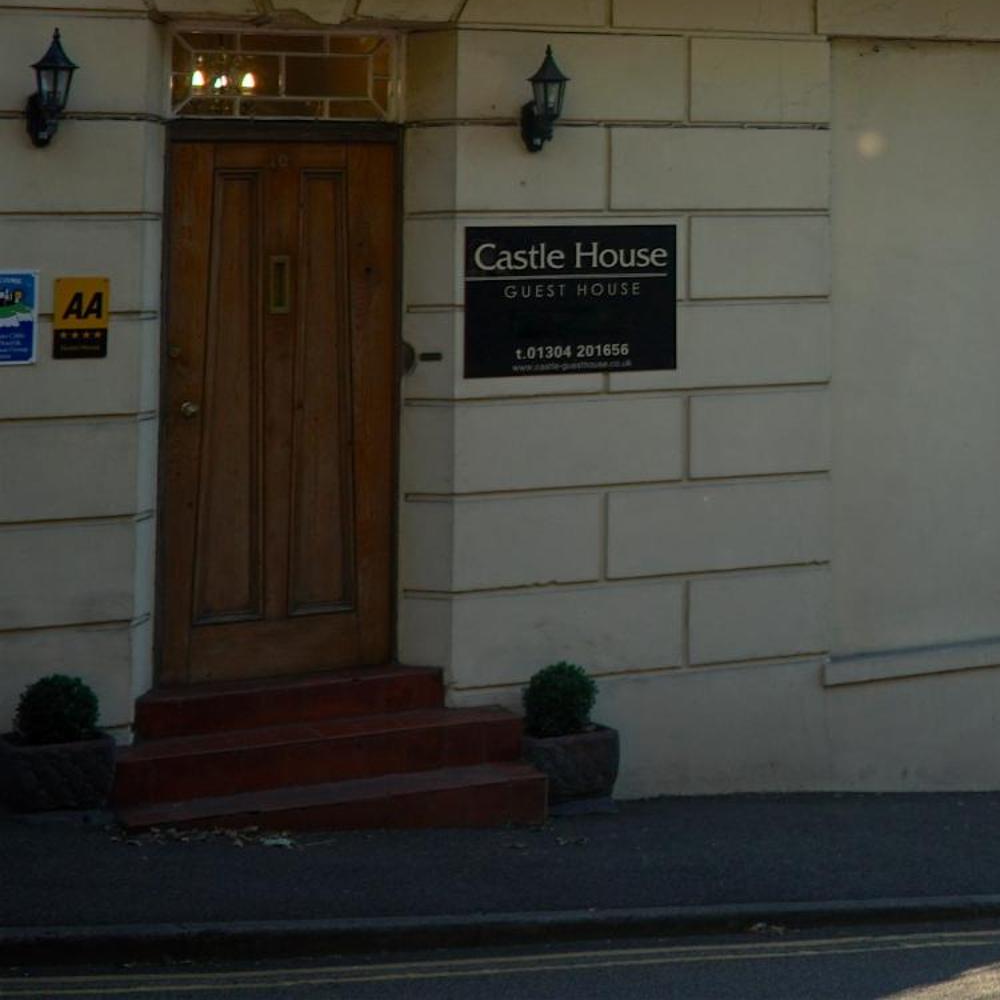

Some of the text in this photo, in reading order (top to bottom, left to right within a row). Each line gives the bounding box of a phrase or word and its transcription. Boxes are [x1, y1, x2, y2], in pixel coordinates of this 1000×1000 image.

[474, 241, 669, 271] Castle House
[503, 281, 641, 299] GUEST HOUSE
[62, 291, 104, 320] AA
[514, 343, 630, 360] t.01304 201656
